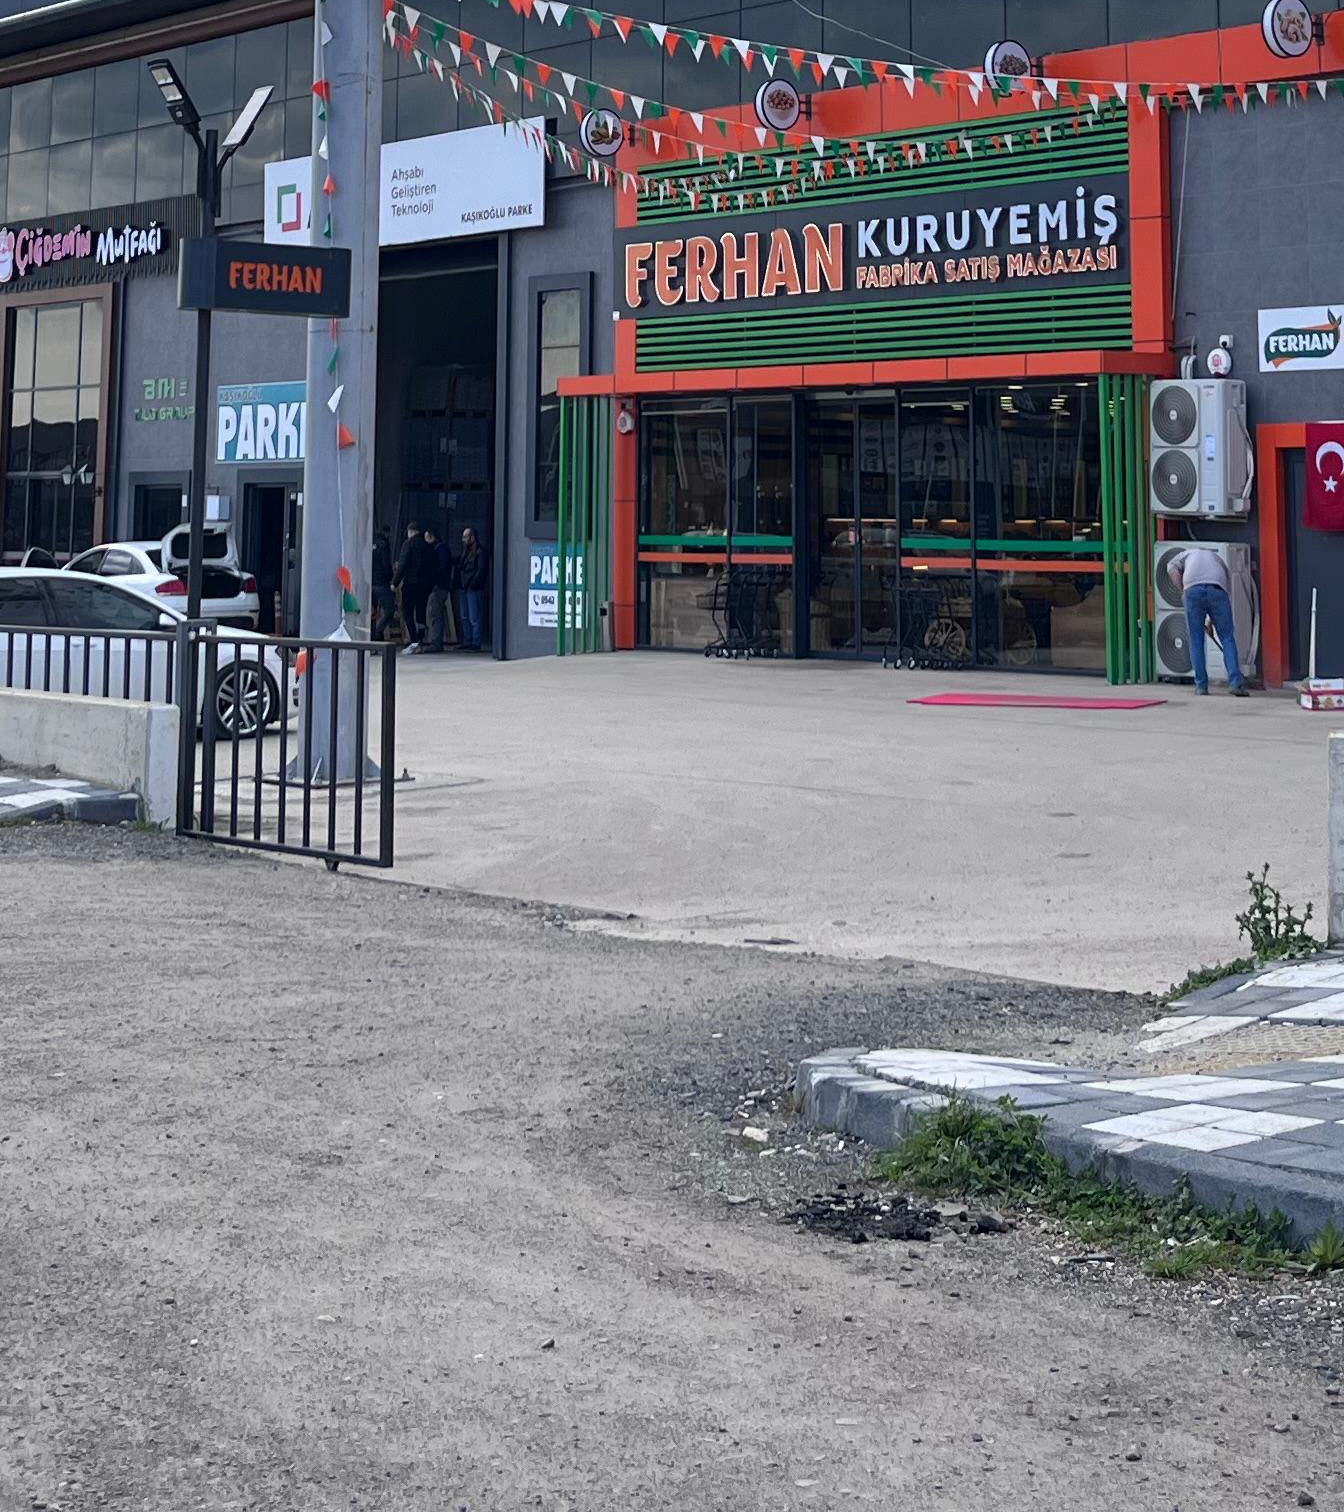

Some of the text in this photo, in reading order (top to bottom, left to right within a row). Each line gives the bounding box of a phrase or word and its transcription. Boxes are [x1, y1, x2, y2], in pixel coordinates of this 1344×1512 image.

[391, 165, 424, 182] Ahşabı
[391, 182, 437, 200] Geliştiren
[391, 199, 434, 218] Teknoloji
[507, 203, 533, 218] PARKE
[624, 186, 1119, 308] FERHAN KURUYEMİŞ
[857, 245, 1118, 289] FABRİKA SATIŞ MAĞAZASI
[228, 262, 323, 295] FERHAN
[1269, 333, 1335, 353] FERHAN
